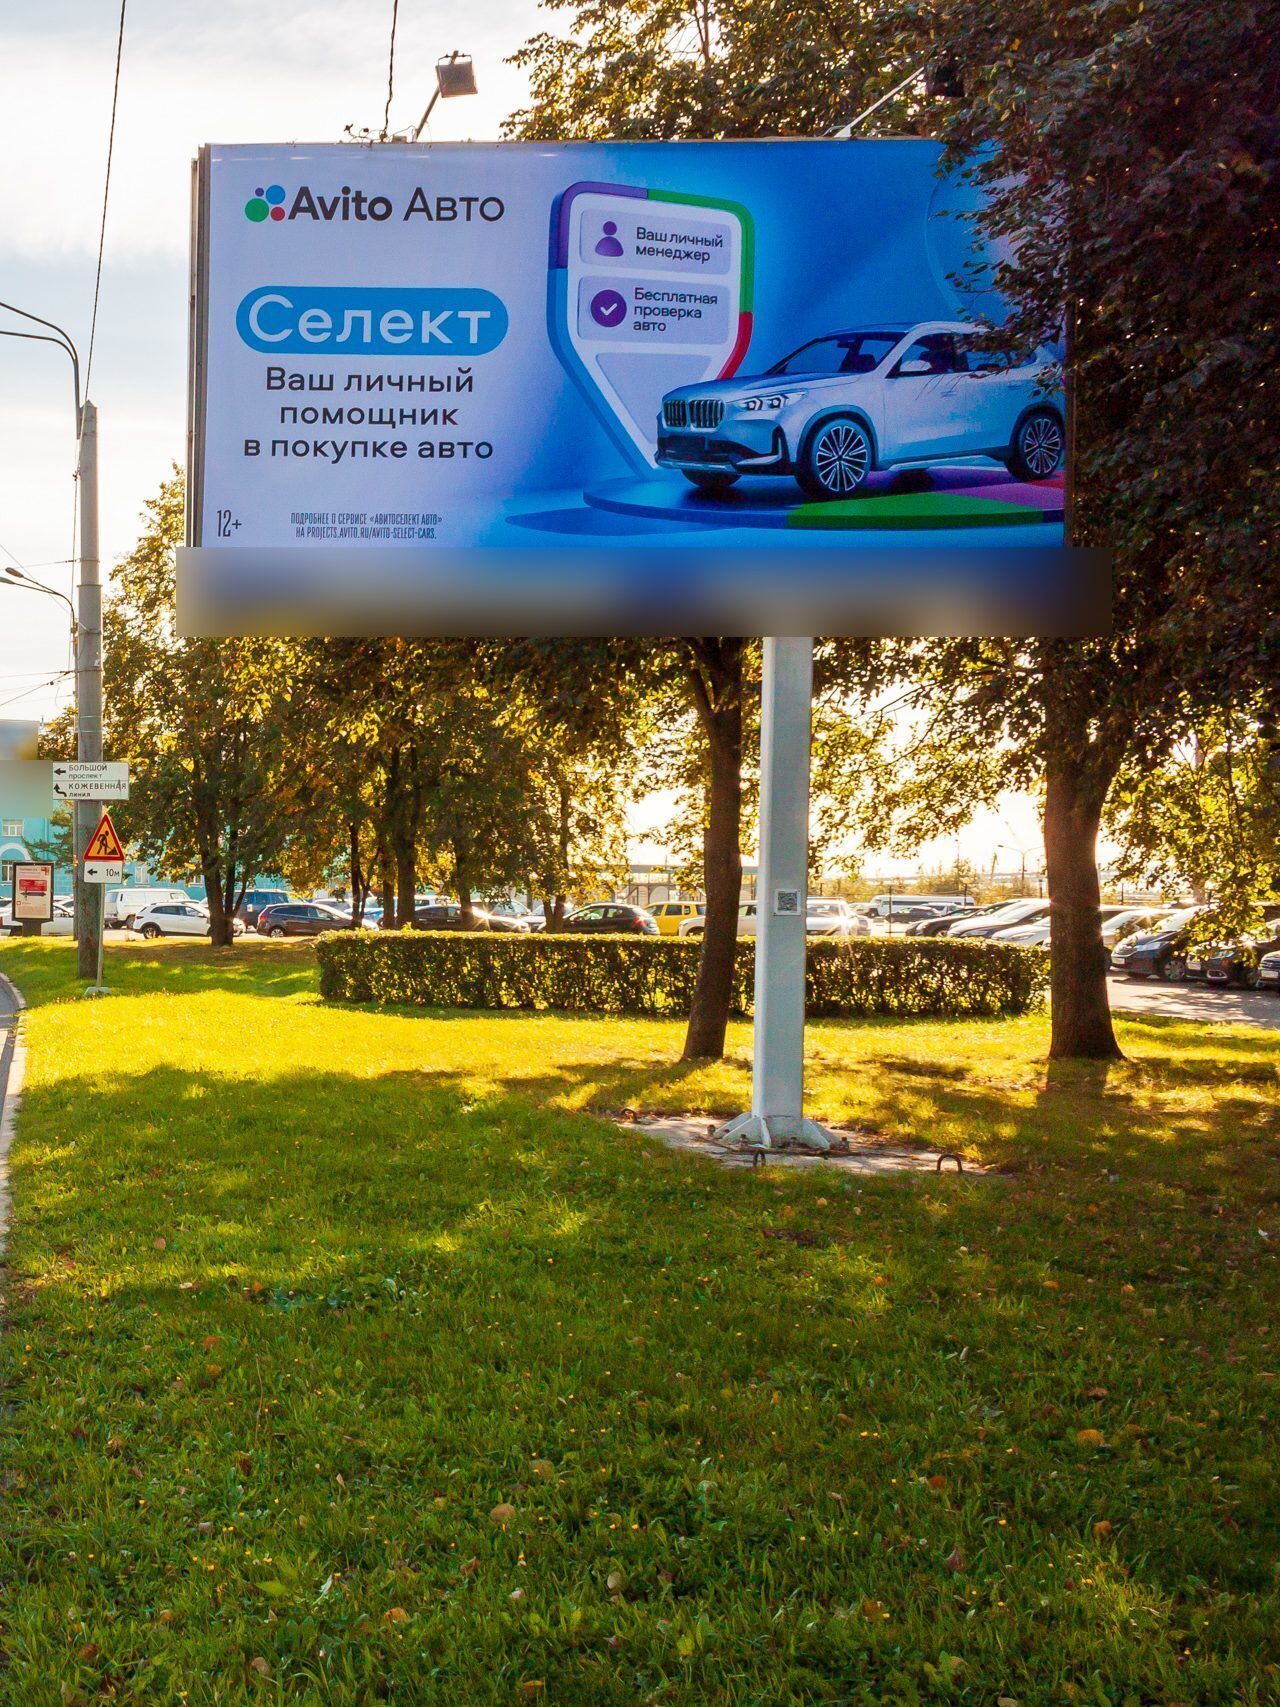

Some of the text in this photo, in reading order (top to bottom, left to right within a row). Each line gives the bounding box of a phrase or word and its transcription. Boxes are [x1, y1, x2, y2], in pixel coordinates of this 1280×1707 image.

[288, 186, 505, 222] Avito Авто
[636, 226, 724, 248] Ваш личный
[635, 246, 710, 264] менеджер
[634, 287, 718, 305] Бесплатная
[248, 294, 491, 344] Селект
[633, 306, 702, 320] проверка
[633, 321, 666, 332] авто
[266, 366, 474, 393] Ваш личный
[280, 406, 460, 429] помощник
[244, 440, 494, 464] в покупке авто
[216, 509, 243, 538] 12+
[290, 512, 330, 525] ПОДРОБНЕЕ
[331, 513, 336, 525] О
[338, 513, 368, 525] СЕРВИСЕ
[295, 526, 305, 538] НА
[68, 782, 127, 790] КОЖЕВЕННАЯ
[105, 868, 120, 877] 10м
